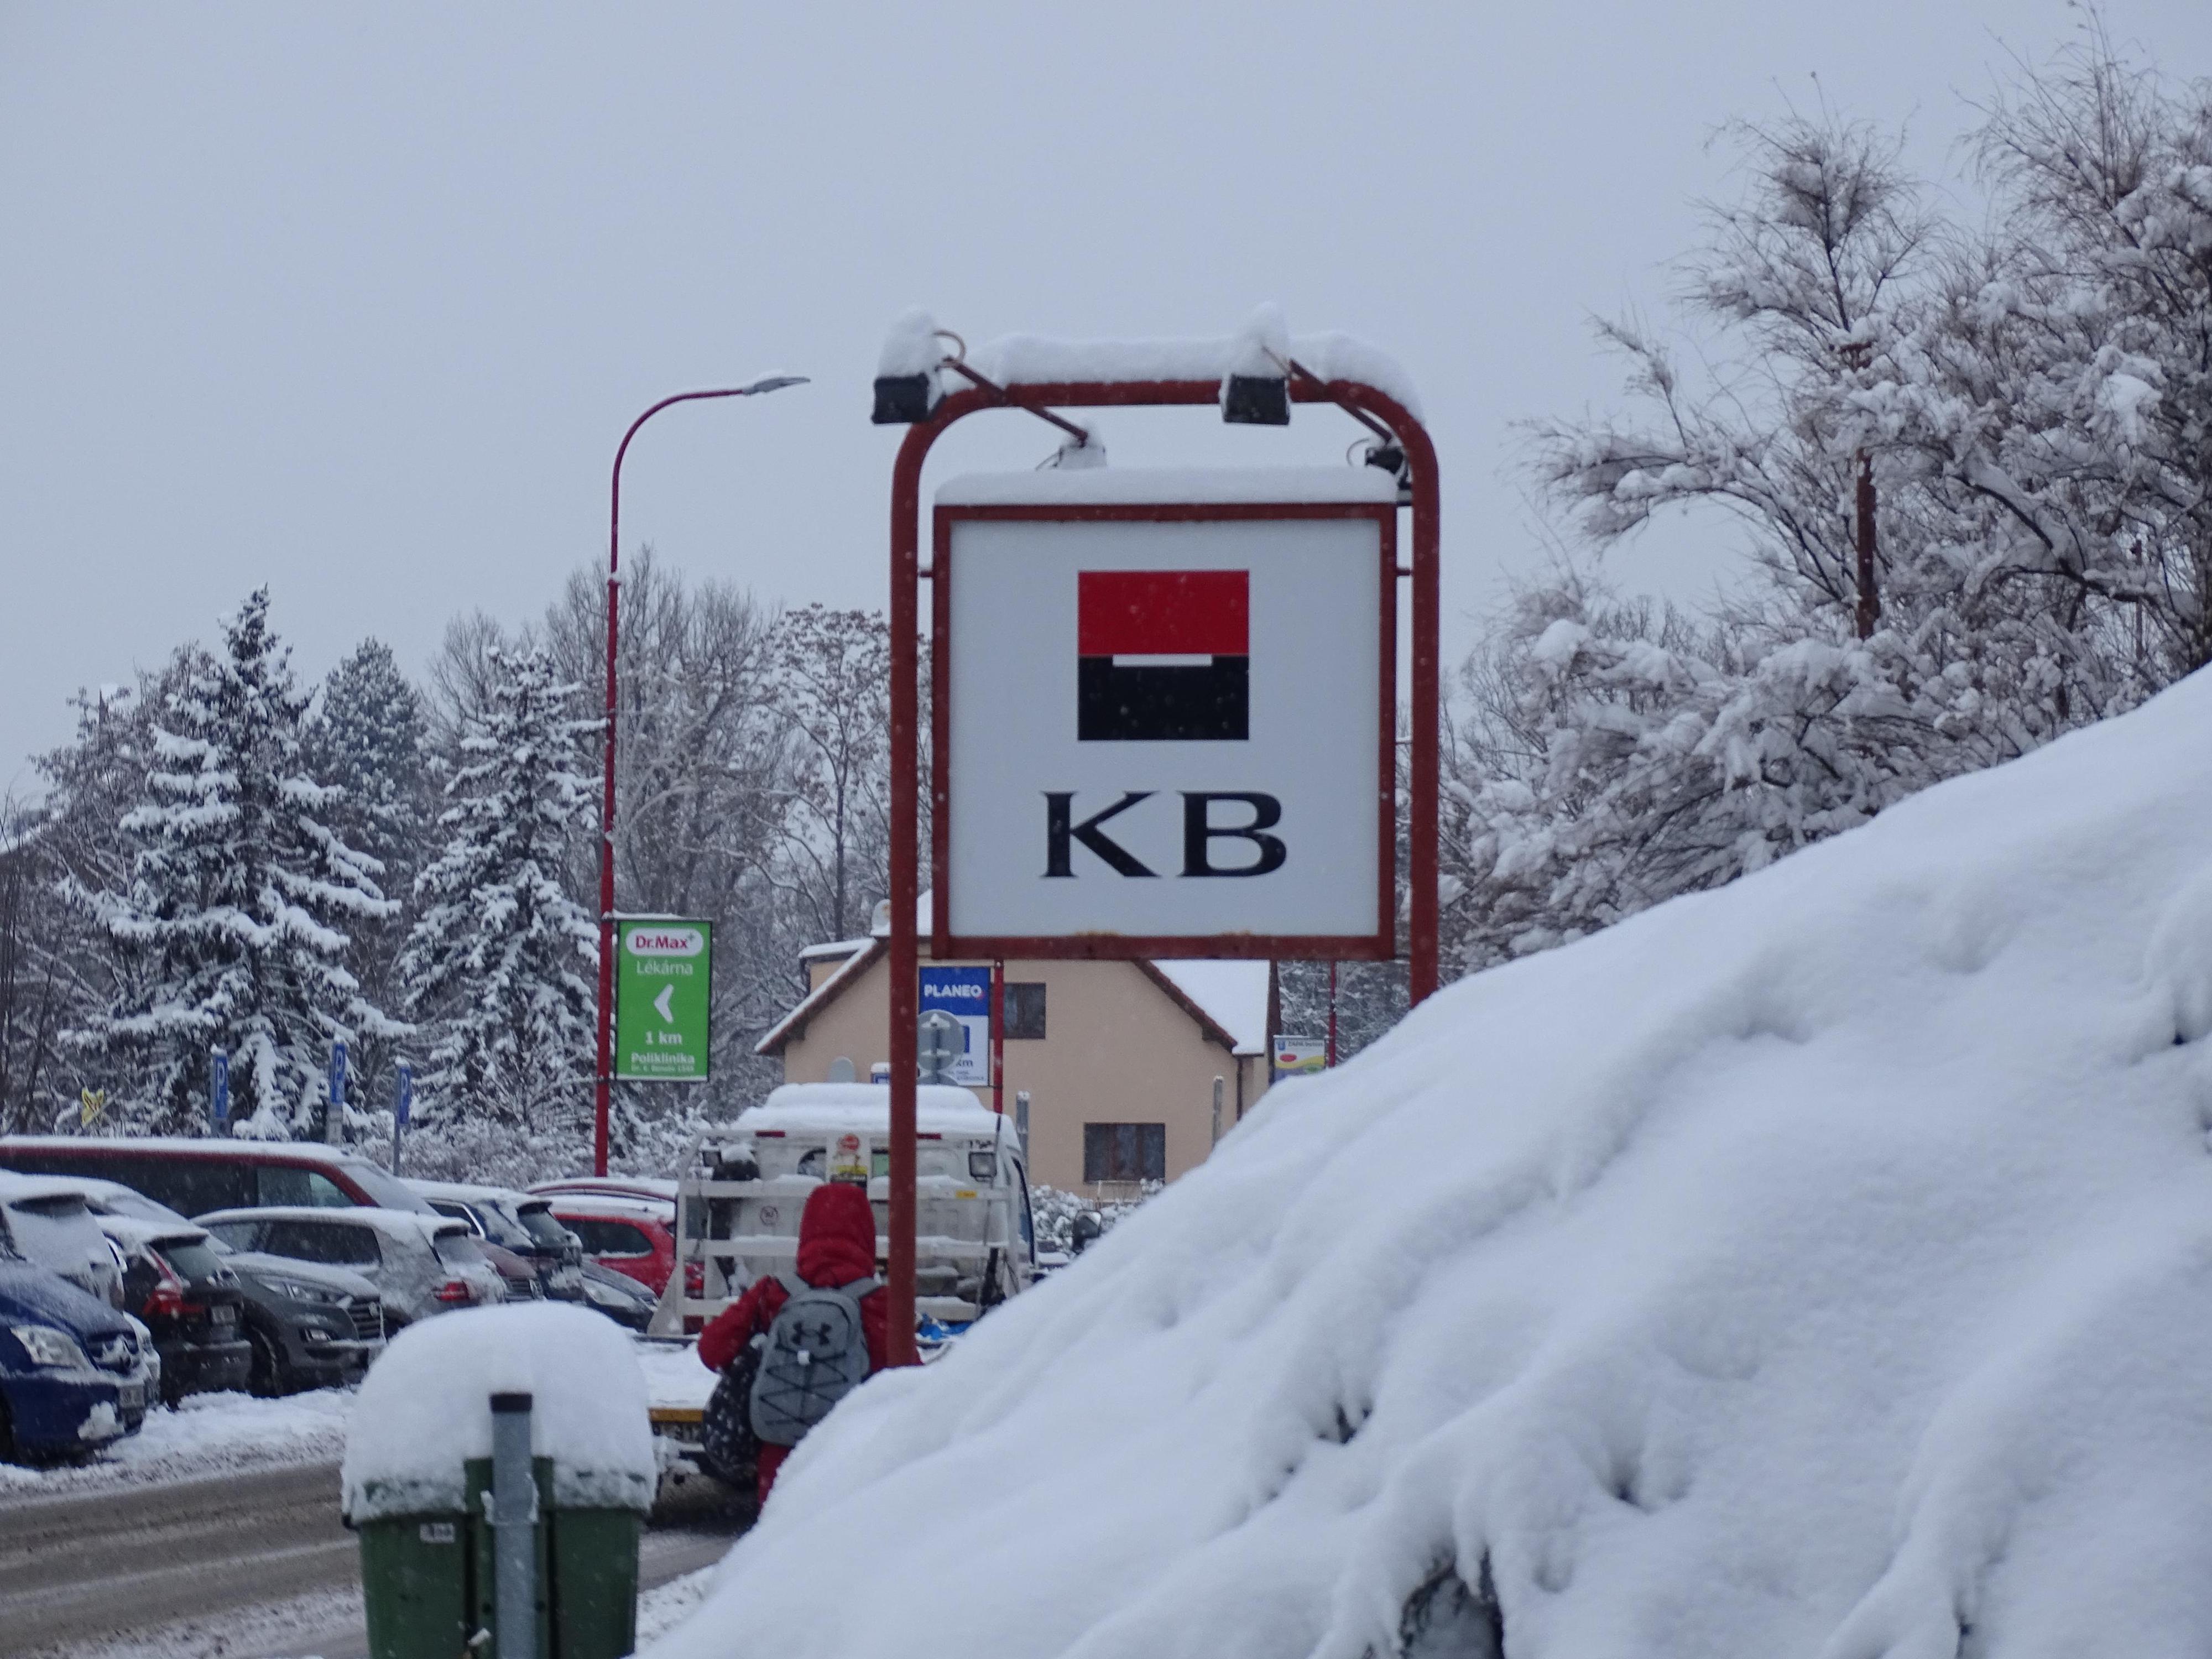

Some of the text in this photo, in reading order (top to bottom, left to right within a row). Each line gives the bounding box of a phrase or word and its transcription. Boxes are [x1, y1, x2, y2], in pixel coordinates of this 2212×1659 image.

[1040, 791, 1287, 878] KB
[635, 935, 688, 949] Dr.Max
[637, 959, 693, 975] Lékárna
[924, 984, 982, 997] PLANEO
[646, 1031, 682, 1045] 1 km
[631, 1052, 695, 1062] Poliklinika
[217, 1061, 225, 1100] P
